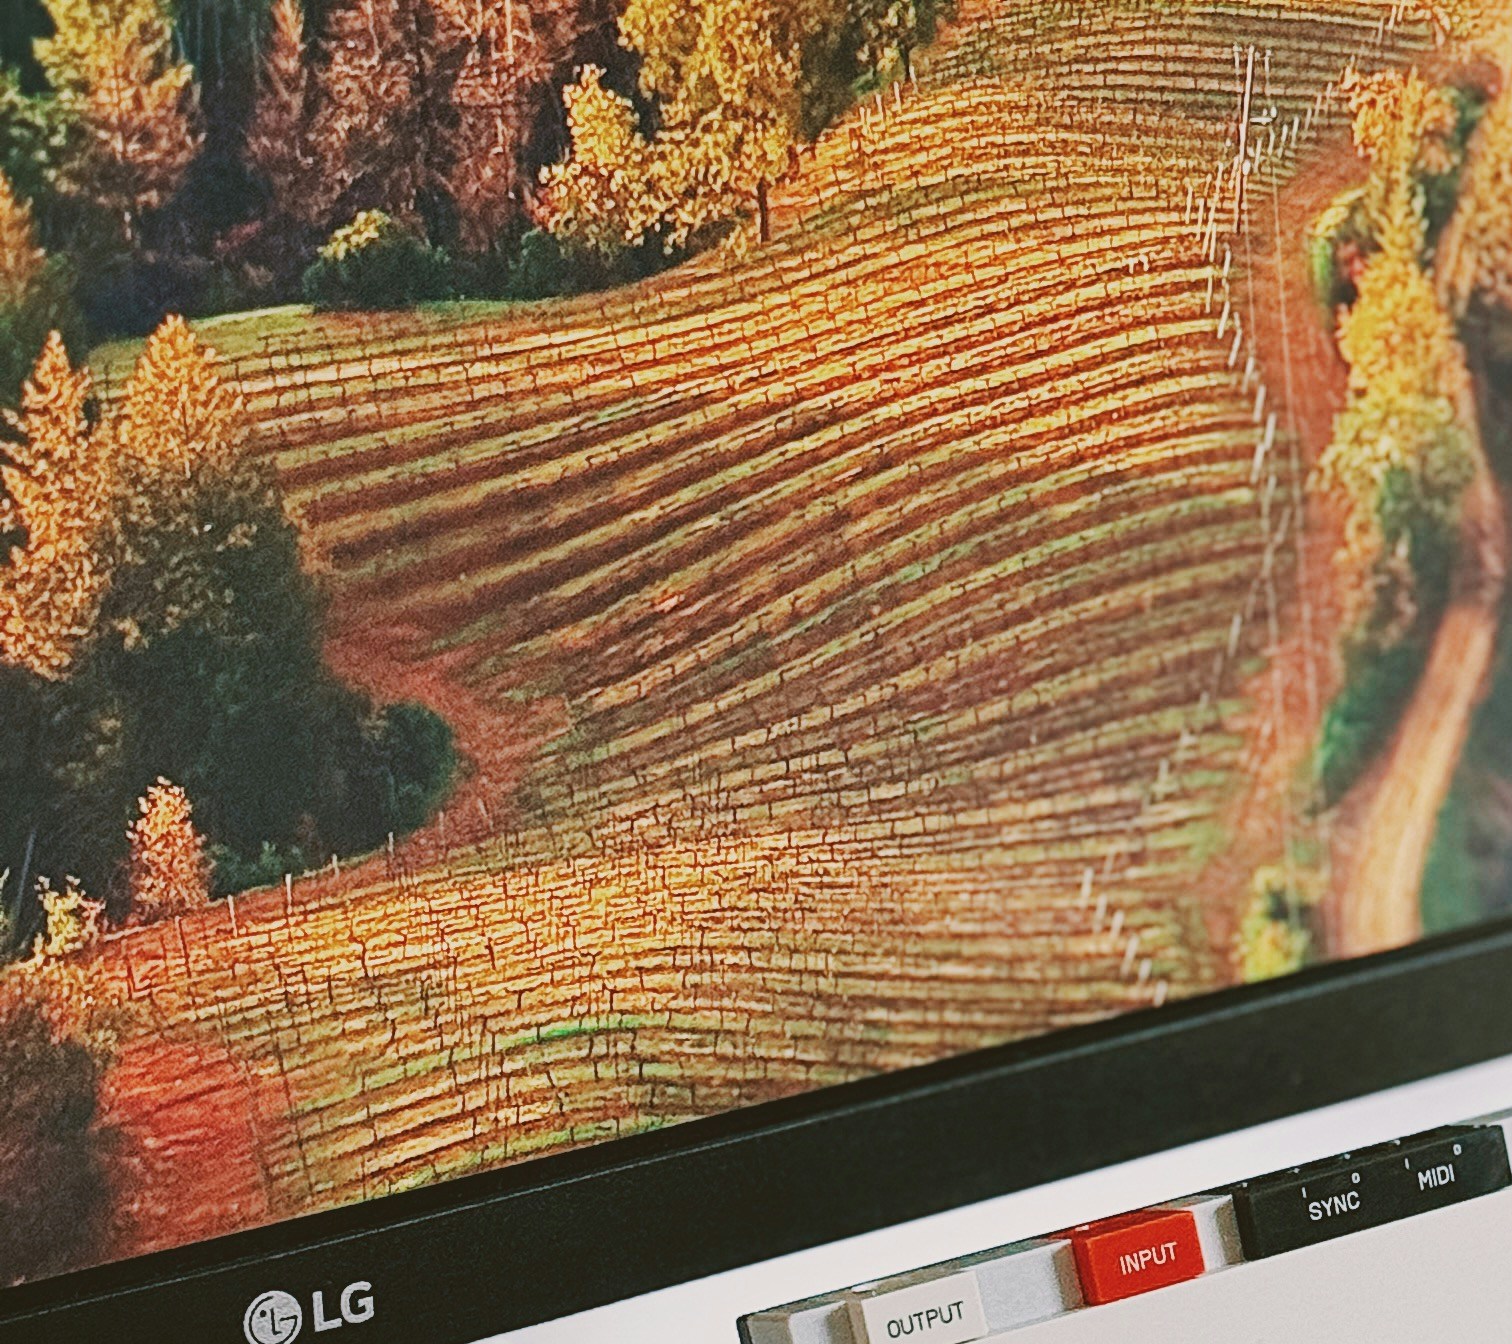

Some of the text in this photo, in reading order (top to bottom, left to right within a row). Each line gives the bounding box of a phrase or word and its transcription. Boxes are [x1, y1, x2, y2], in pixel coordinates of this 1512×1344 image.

[1417, 1163, 1455, 1191] MIDI
[1308, 1191, 1361, 1221] SYNC
[1119, 1242, 1178, 1275] INPUT
[312, 1281, 375, 1332] LG
[887, 1301, 964, 1339] OUTPUT
